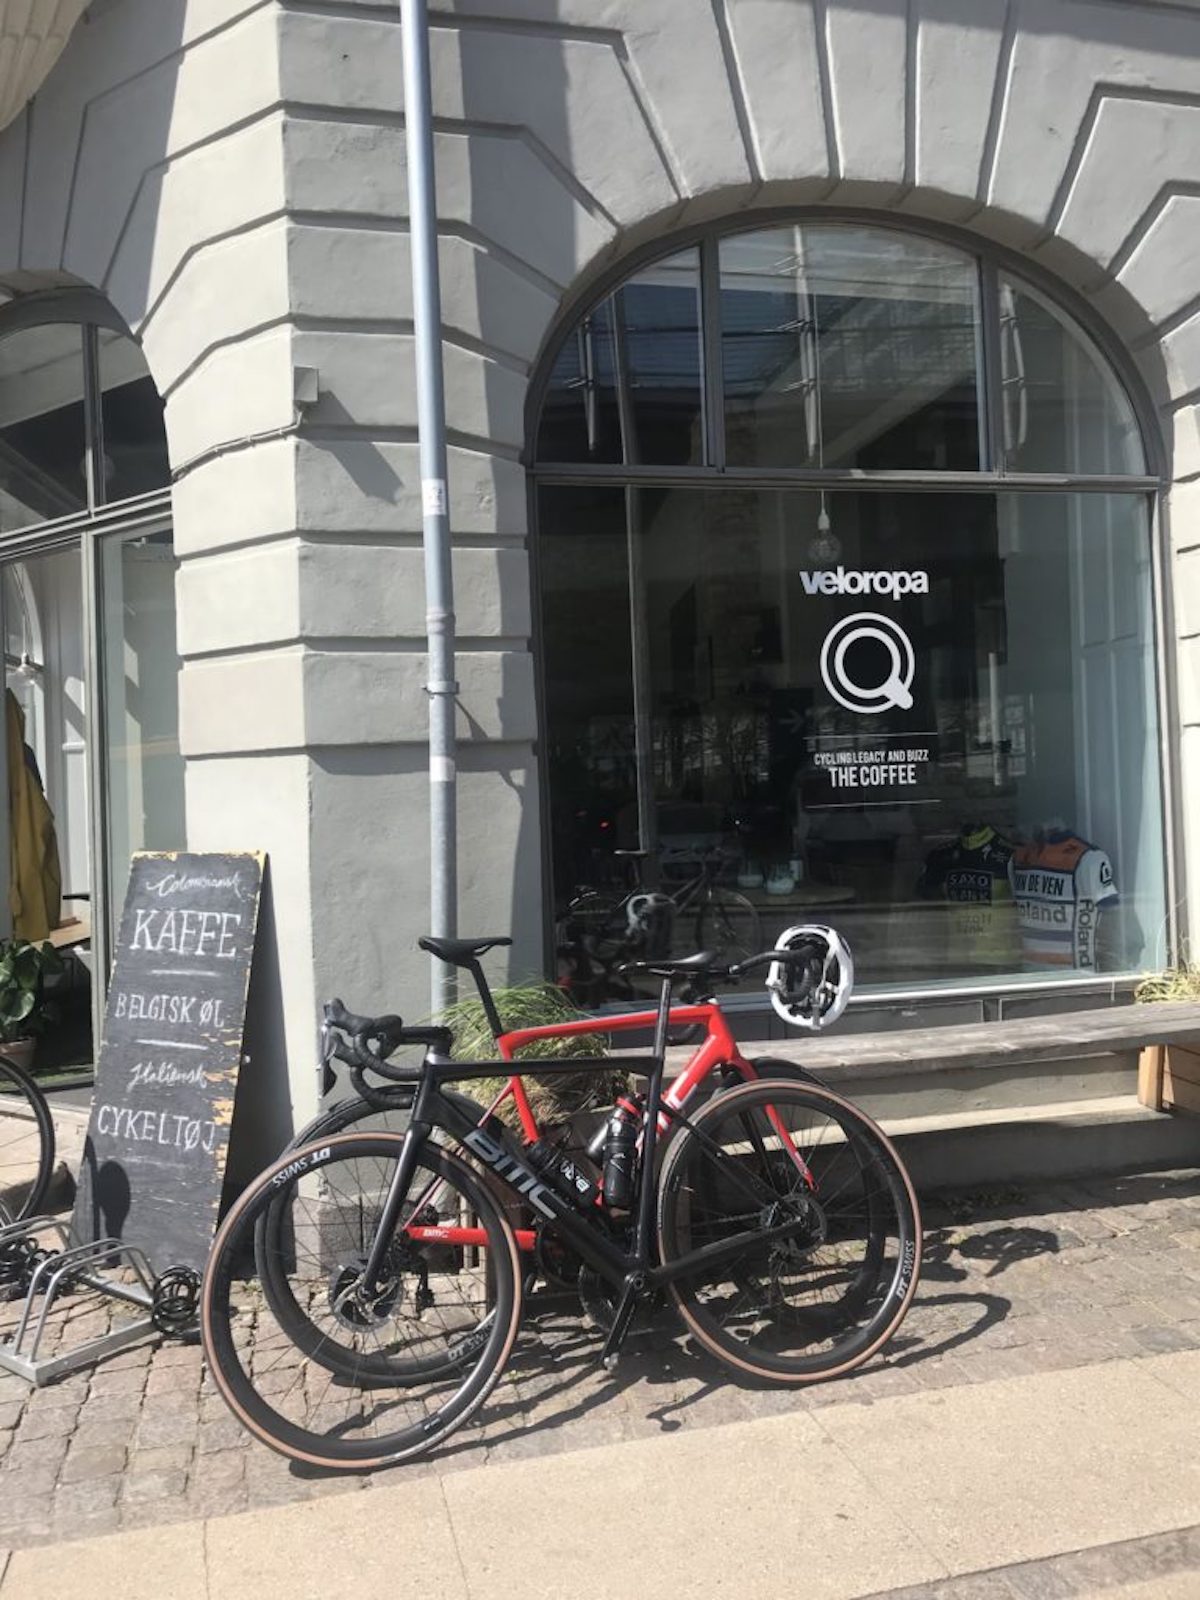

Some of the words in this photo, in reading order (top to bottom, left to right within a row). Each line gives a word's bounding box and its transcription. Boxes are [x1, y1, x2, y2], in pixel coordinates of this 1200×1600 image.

[799, 566, 929, 600] veloropa
[814, 752, 853, 765] CYCLING
[853, 750, 885, 764] LEGACY
[887, 750, 906, 762] AND
[906, 749, 929, 762] BUZZ
[828, 766, 859, 788] THE
[860, 764, 917, 786] COFFEE
[949, 874, 989, 887] SAXO
[1041, 876, 1065, 897] VEN
[129, 908, 241, 958] KAFFE
[1079, 899, 1095, 968] Roland
[114, 993, 196, 1023] BELGISK
[199, 998, 225, 1028] ØL
[97, 1105, 216, 1151] CYKELTØJ
[311, 1146, 331, 1164] DT
[272, 1157, 308, 1188] SWISS
[463, 1129, 570, 1220] BMC
[902, 1239, 915, 1278] SWISS
[896, 1277, 909, 1300] DT
